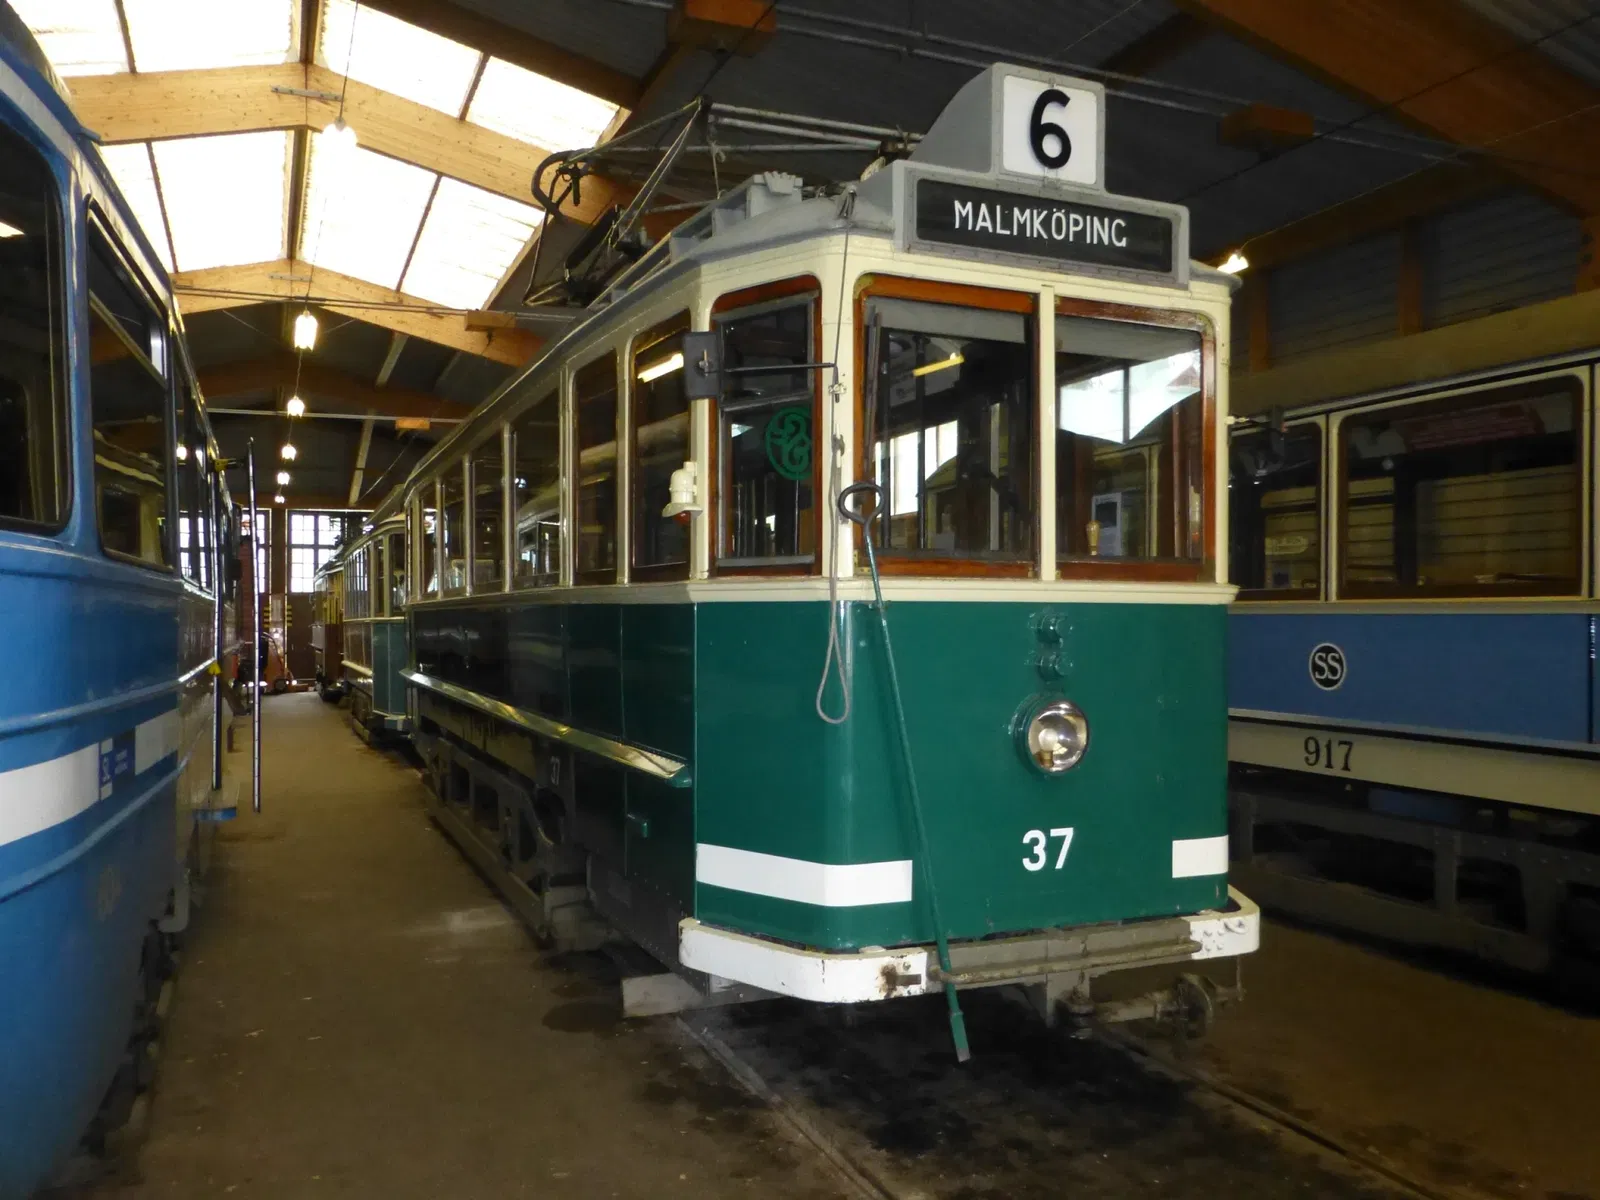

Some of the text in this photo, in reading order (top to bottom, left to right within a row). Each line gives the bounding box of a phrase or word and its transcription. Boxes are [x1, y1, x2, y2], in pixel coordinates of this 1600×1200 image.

[1030, 88, 1072, 169] 6
[953, 199, 1128, 248] MALMKÖPING
[1314, 652, 1341, 680] SS
[1303, 735, 1354, 772] 917
[1021, 827, 1074, 872] 37
